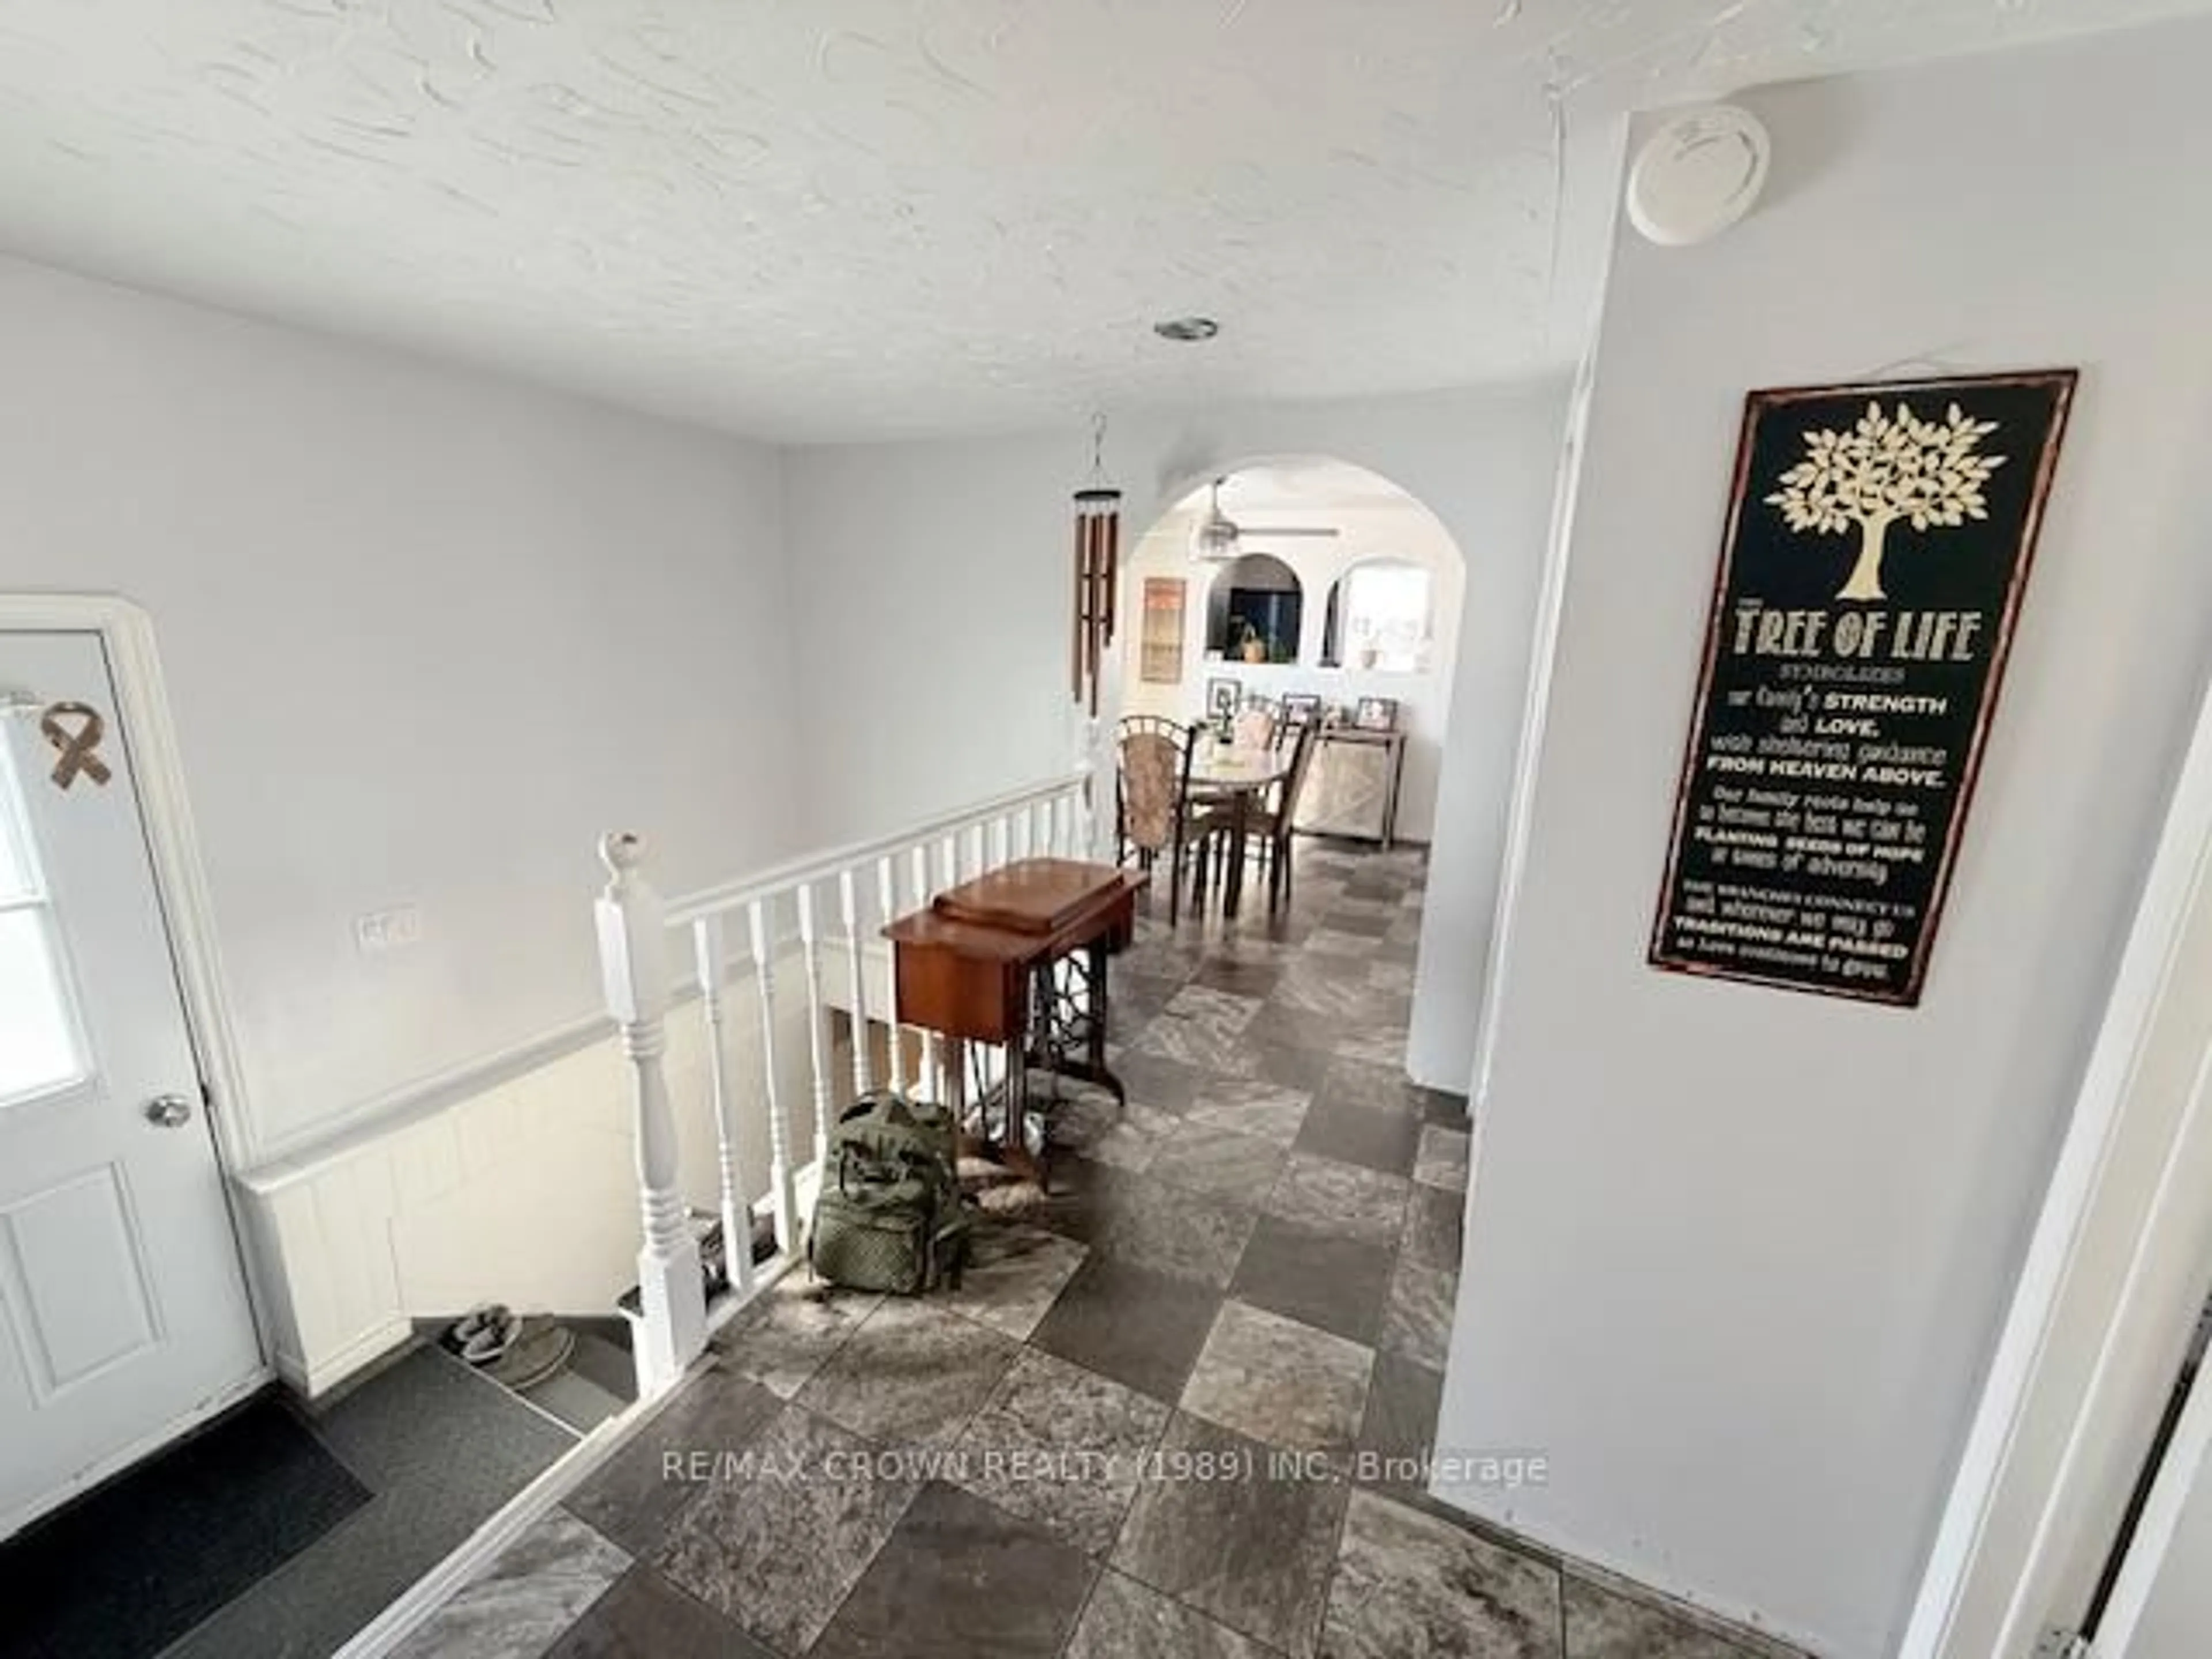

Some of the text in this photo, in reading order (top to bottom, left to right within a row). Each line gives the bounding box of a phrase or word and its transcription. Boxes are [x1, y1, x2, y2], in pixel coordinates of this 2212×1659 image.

[1734, 608, 1982, 661] TREE OF LIFE
[1823, 692, 1948, 715] STRENGTH
[1706, 756, 1948, 787] FROM HEAVEN ABOVE.
[1695, 826, 1778, 847] PLANTING
[1845, 842, 1870, 857] OF
[1674, 916, 1783, 942] TRADITIONS
[1785, 931, 1826, 949] ARE
